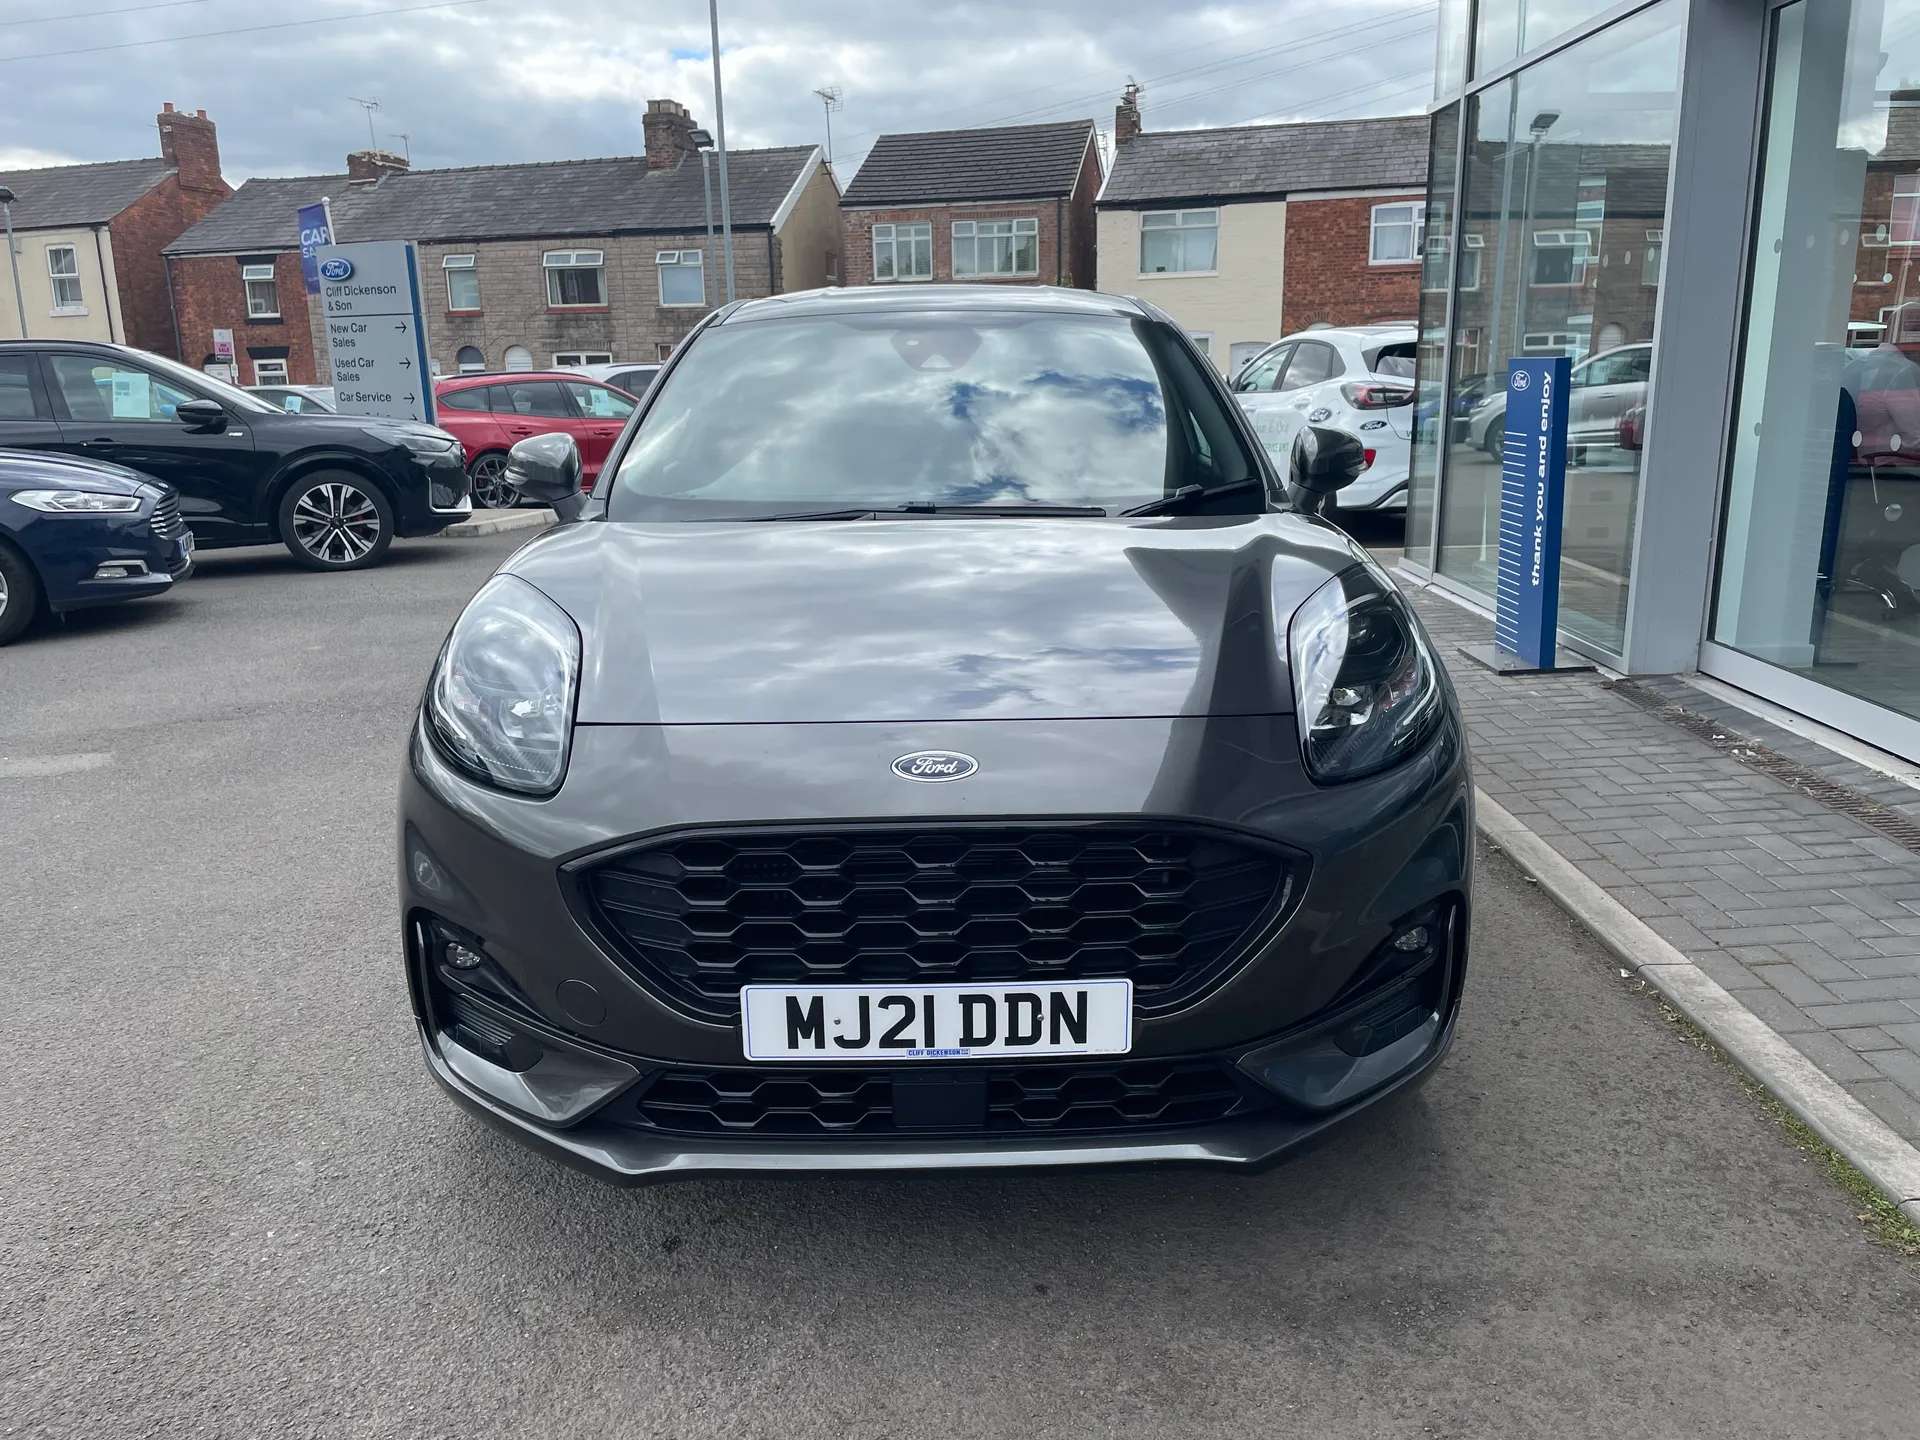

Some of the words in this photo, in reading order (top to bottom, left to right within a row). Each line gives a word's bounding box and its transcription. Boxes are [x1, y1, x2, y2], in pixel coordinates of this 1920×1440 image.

[326, 286, 342, 297] Cliff
[343, 285, 397, 296] Dickenson
[328, 301, 334, 311] &
[335, 300, 352, 311] Son
[330, 324, 349, 334] New
[350, 322, 367, 333] Car
[332, 337, 356, 348] Sales
[335, 359, 357, 369] Used
[358, 357, 375, 368] Car
[337, 371, 360, 382] Sales
[339, 391, 355, 402] Car
[355, 391, 392, 402] Service
[1539, 371, 1552, 431] enjoy
[1538, 435, 1547, 478] and
[1535, 481, 1545, 521] you
[1531, 523, 1543, 586] thank
[911, 757, 959, 774] Ford
[785, 994, 936, 1050] MJ21
[958, 990, 1089, 1047] DDN
